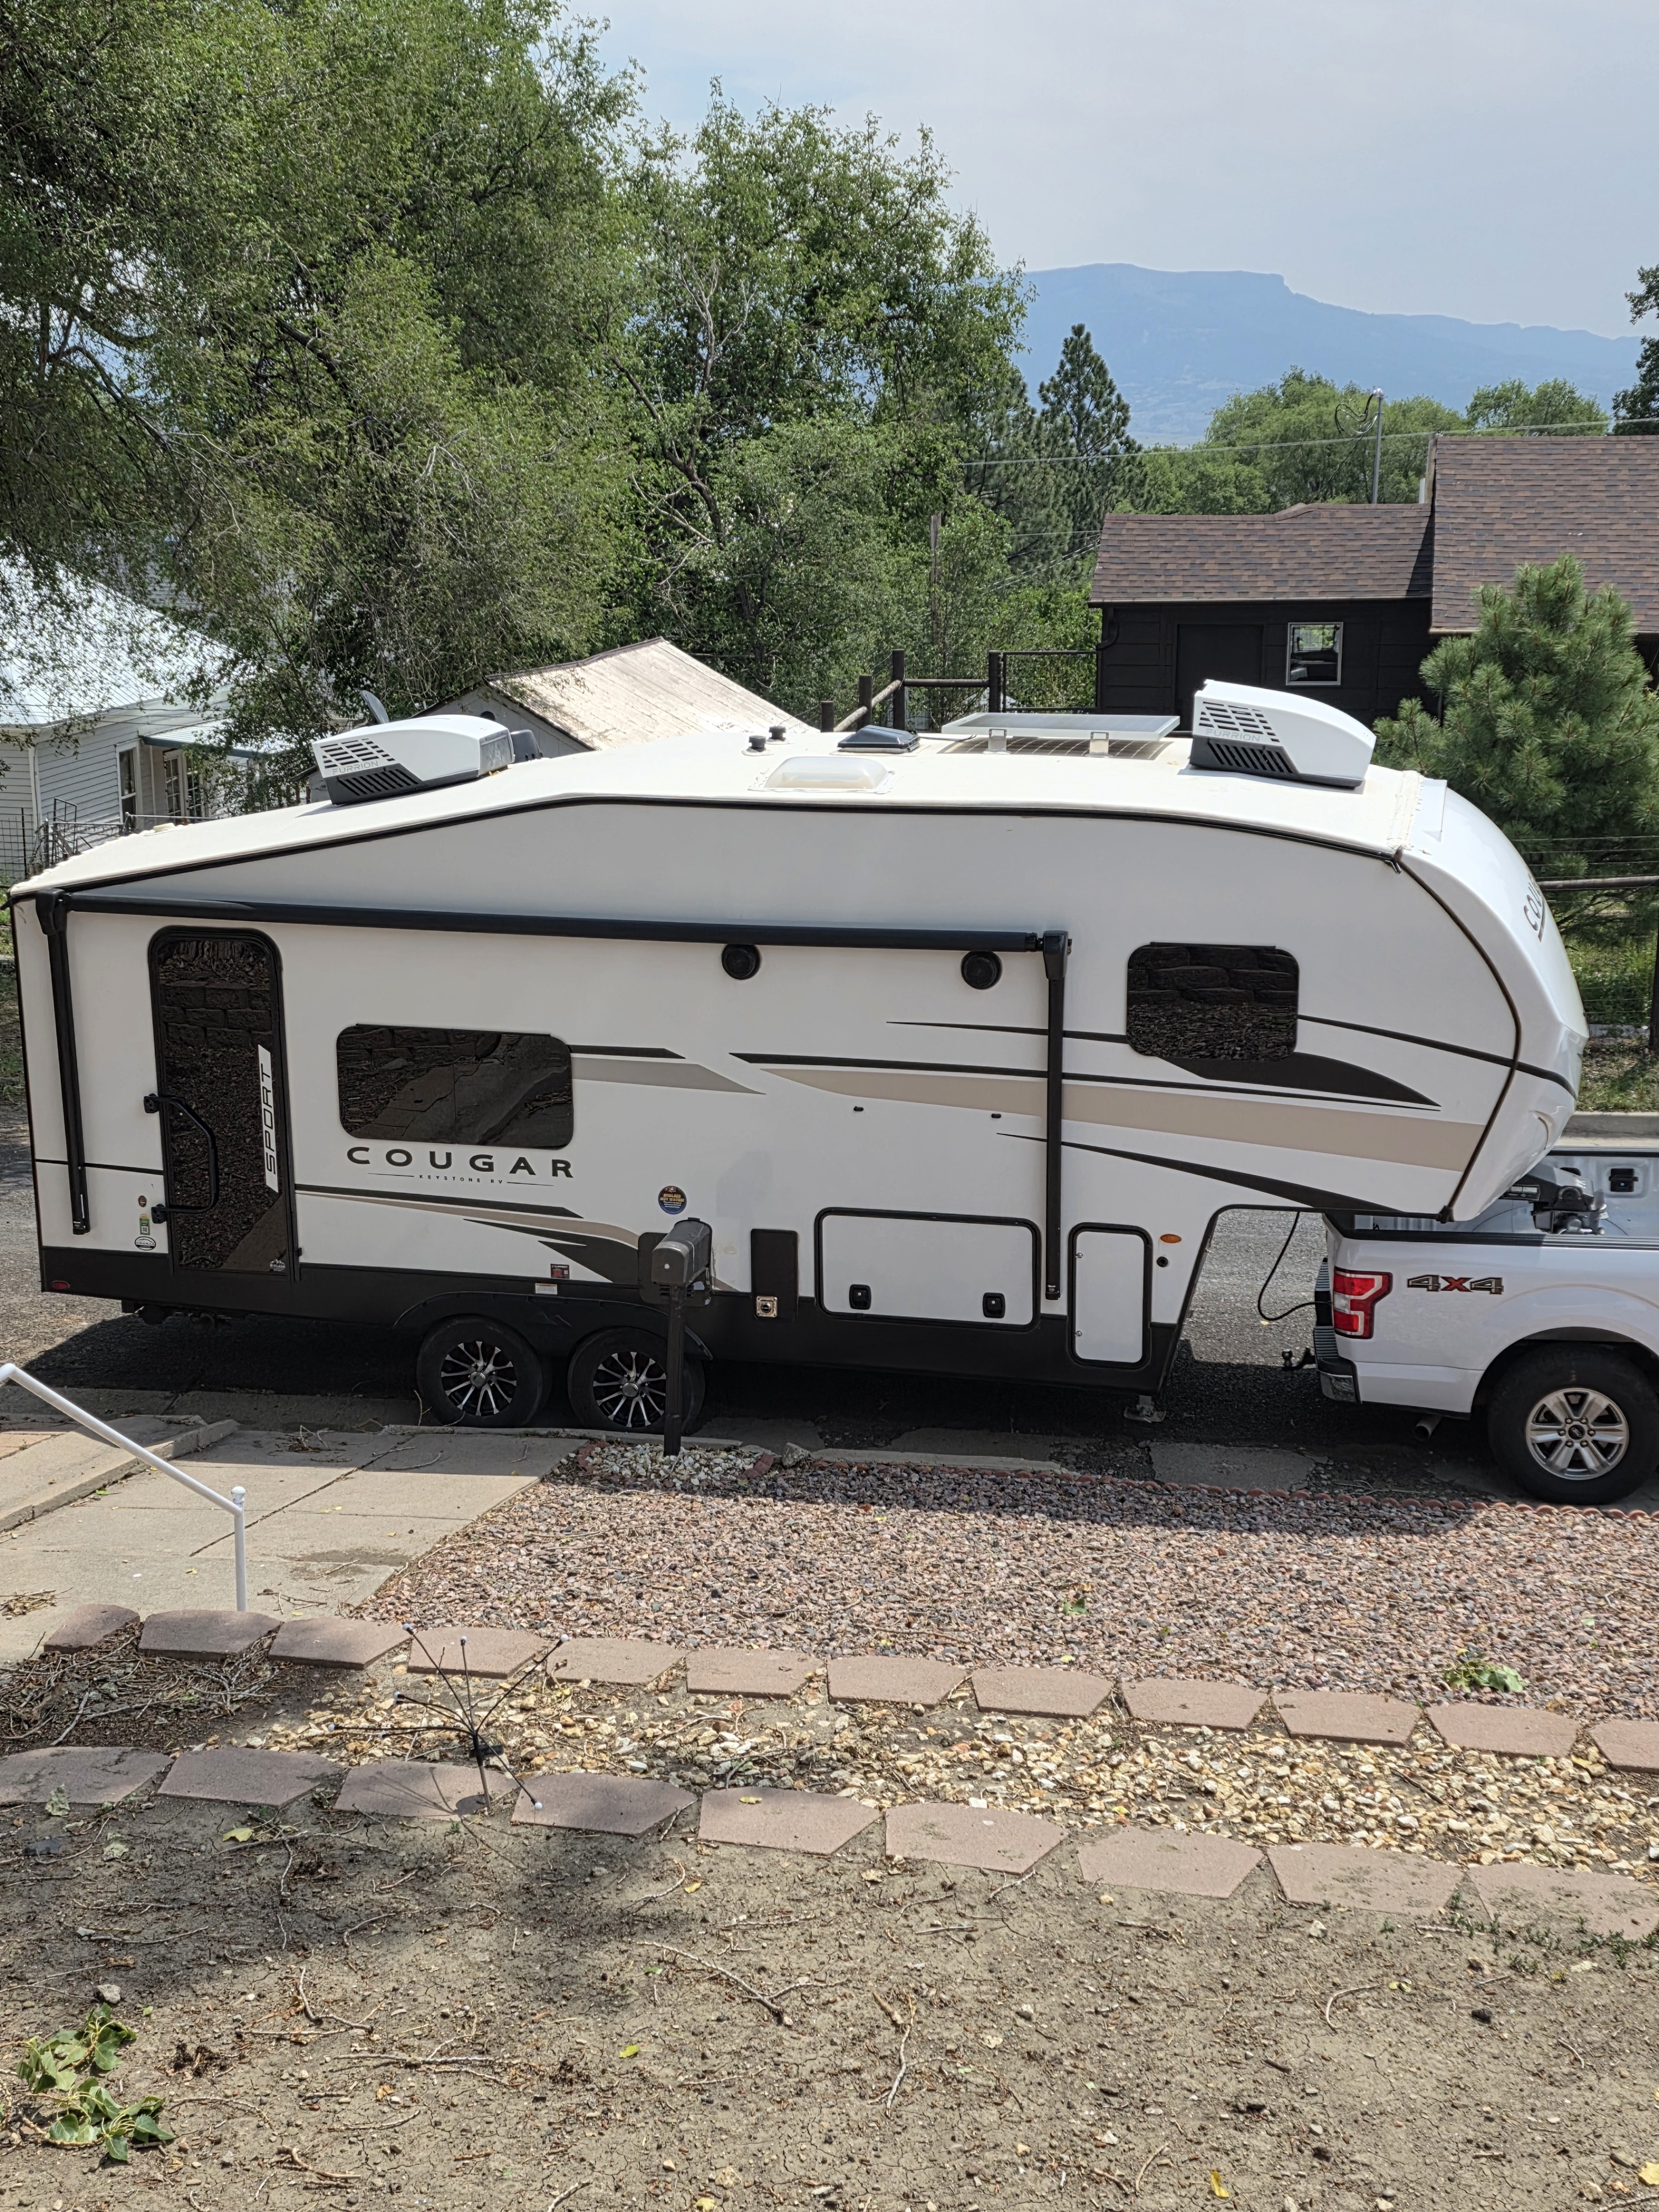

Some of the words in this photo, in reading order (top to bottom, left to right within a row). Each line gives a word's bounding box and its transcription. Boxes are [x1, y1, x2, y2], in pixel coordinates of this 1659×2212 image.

[1206, 728, 1261, 742] FURRION
[332, 760, 379, 775] FURRION
[260, 1062, 276, 1175] SPORT
[347, 1146, 574, 1178] COUGAR
[419, 1174, 481, 1183] KEYSTONE
